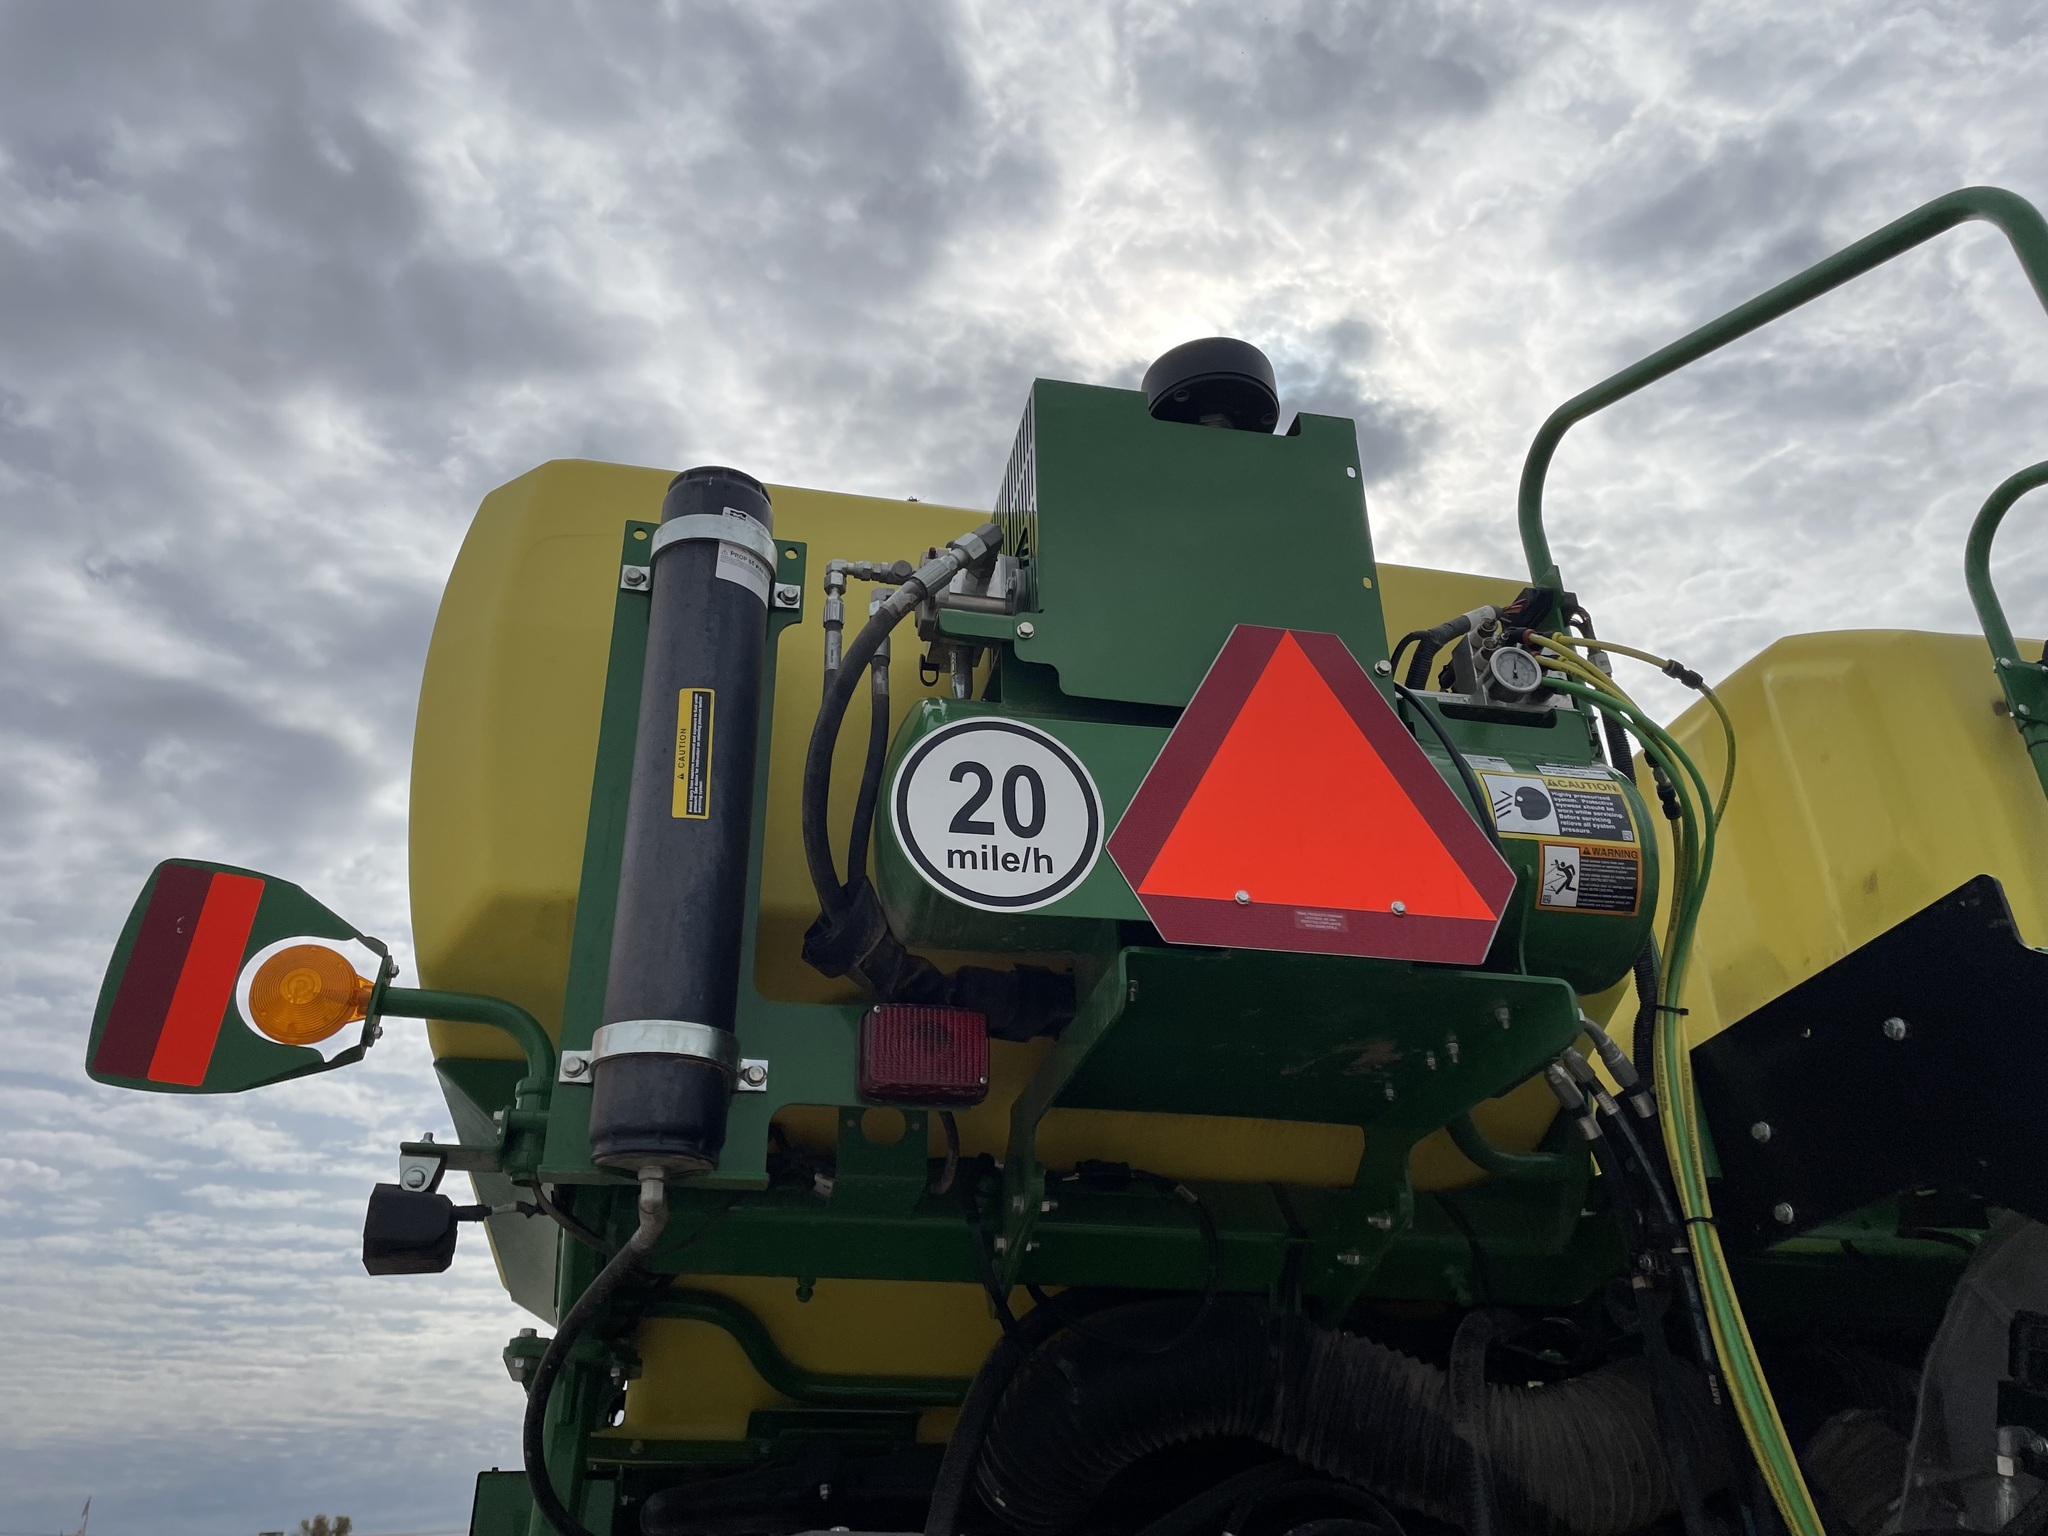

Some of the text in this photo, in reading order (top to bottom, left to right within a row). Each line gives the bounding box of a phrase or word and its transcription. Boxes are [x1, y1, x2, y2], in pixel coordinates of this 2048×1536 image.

[678, 728, 687, 768] CAUTION
[948, 760, 1046, 838] 20
[1558, 780, 1617, 792] CAUTION
[947, 844, 1054, 874] mile/h
[1592, 847, 1638, 859] WARNING
